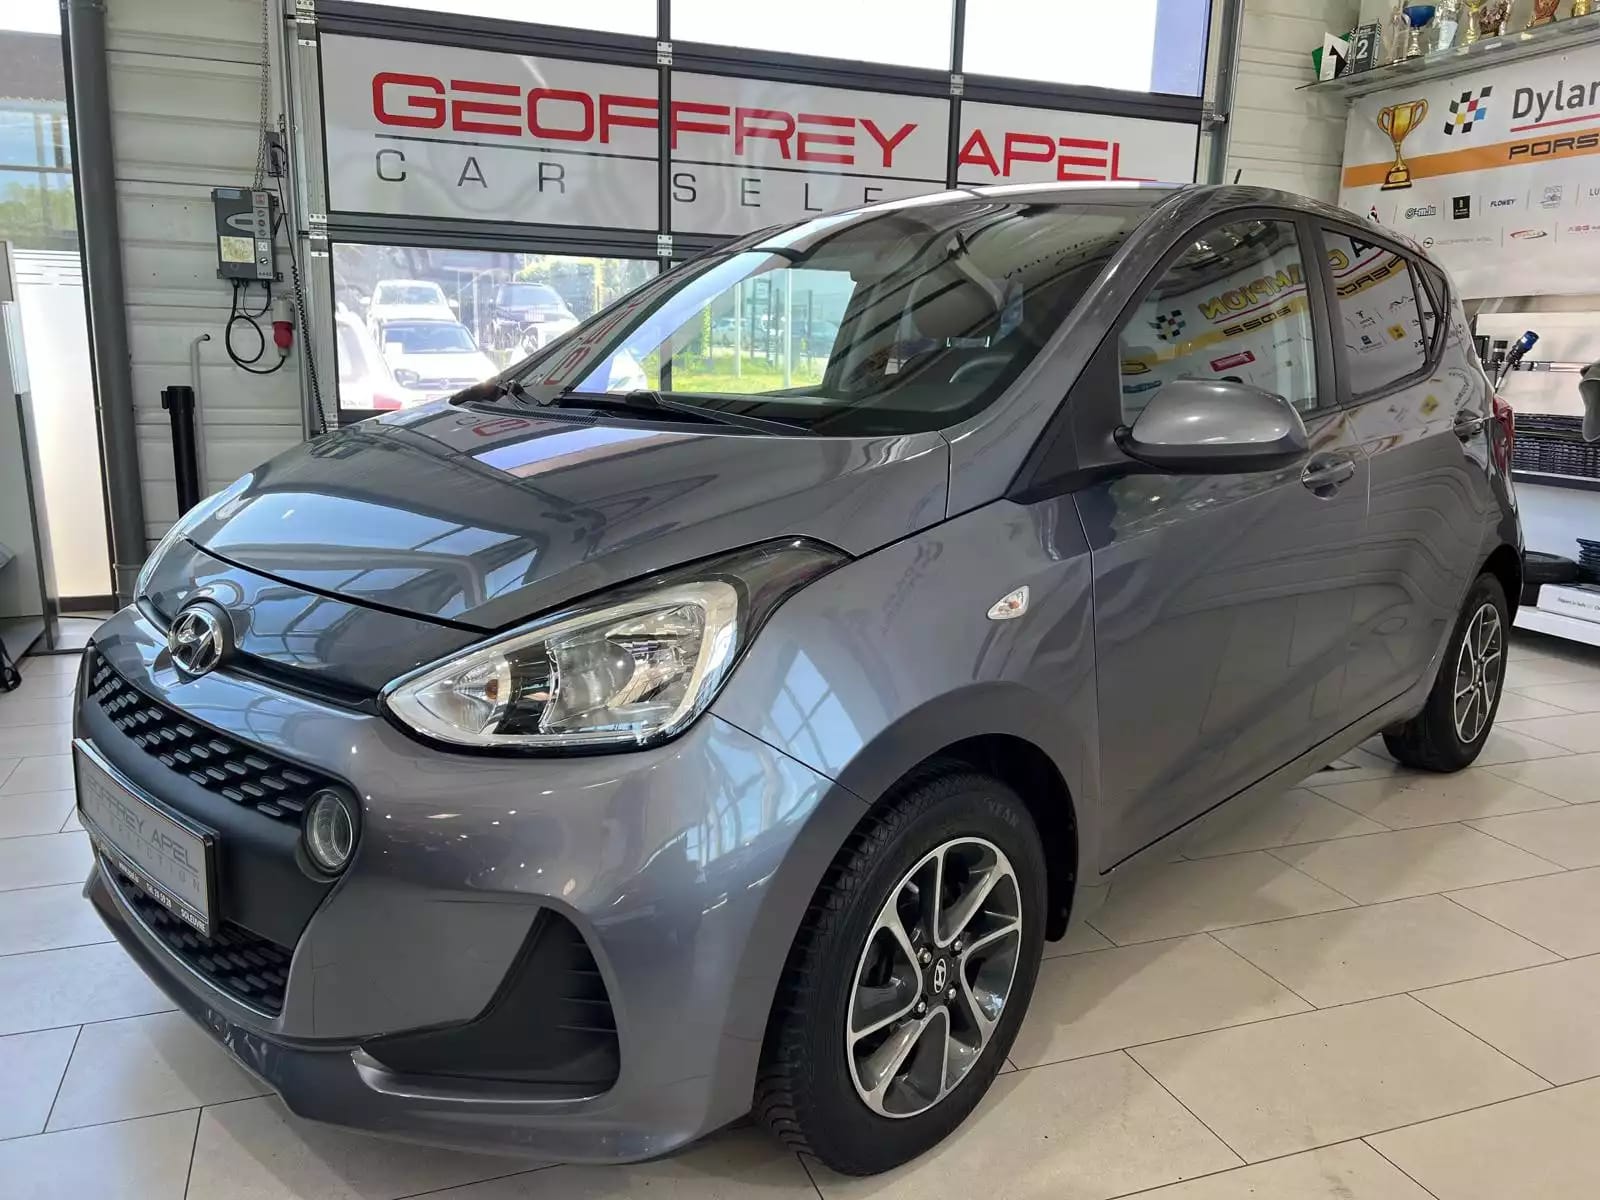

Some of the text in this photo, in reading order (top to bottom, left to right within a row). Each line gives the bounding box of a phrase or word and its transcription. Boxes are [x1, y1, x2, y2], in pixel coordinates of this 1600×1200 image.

[372, 71, 1158, 182] GEOFFREY APEL
[1508, 133, 1599, 160] PORS
[375, 148, 566, 195] CAR
[151, 828, 199, 873] APEL
